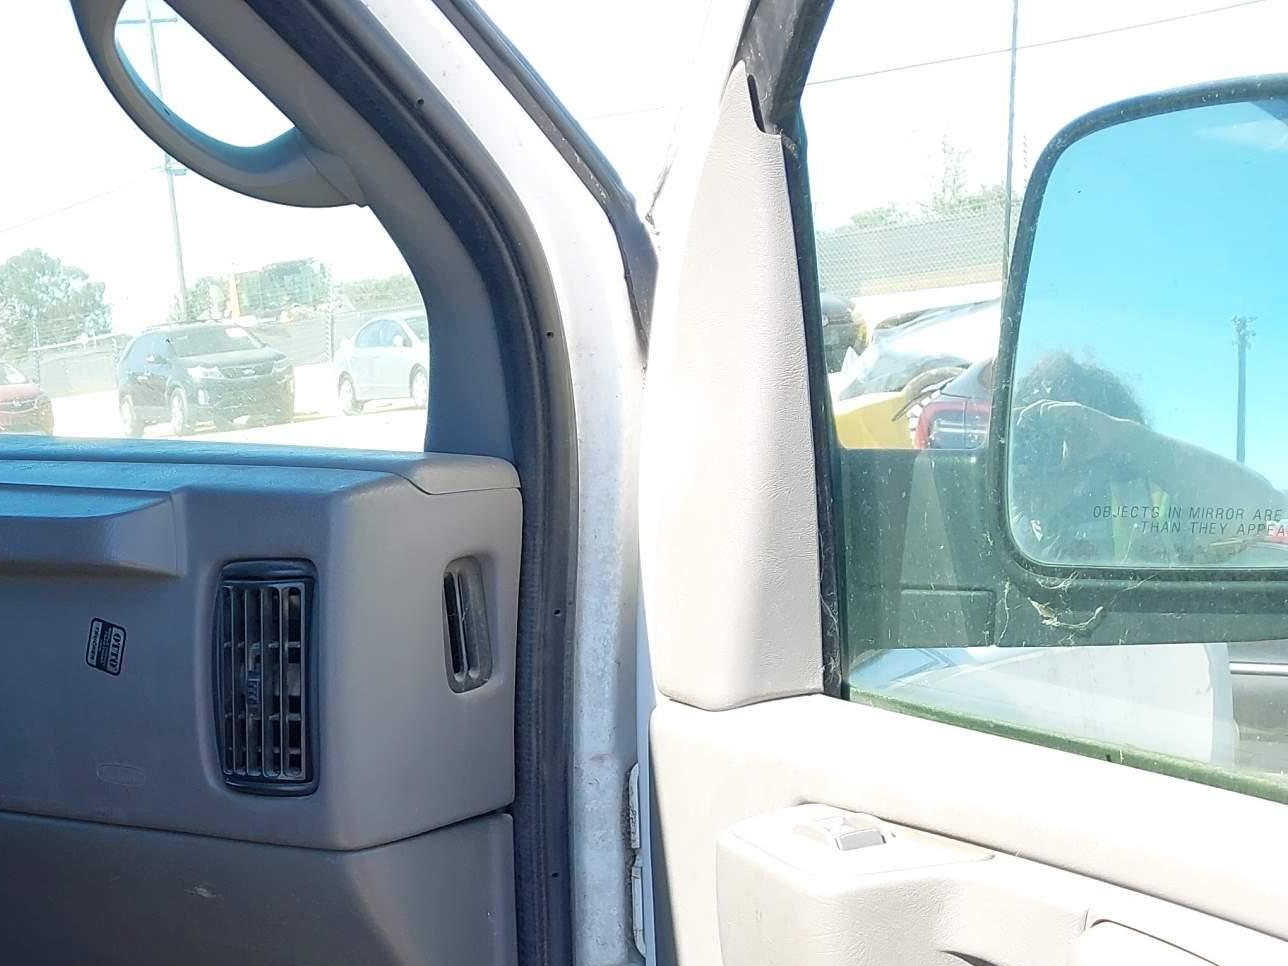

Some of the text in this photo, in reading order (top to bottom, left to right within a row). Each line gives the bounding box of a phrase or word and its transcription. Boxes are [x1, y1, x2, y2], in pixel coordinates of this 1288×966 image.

[1093, 506, 1283, 522] OBJECTS IN MIRROR ARE
[1141, 521, 1288, 536] THAN THEY APPEA
